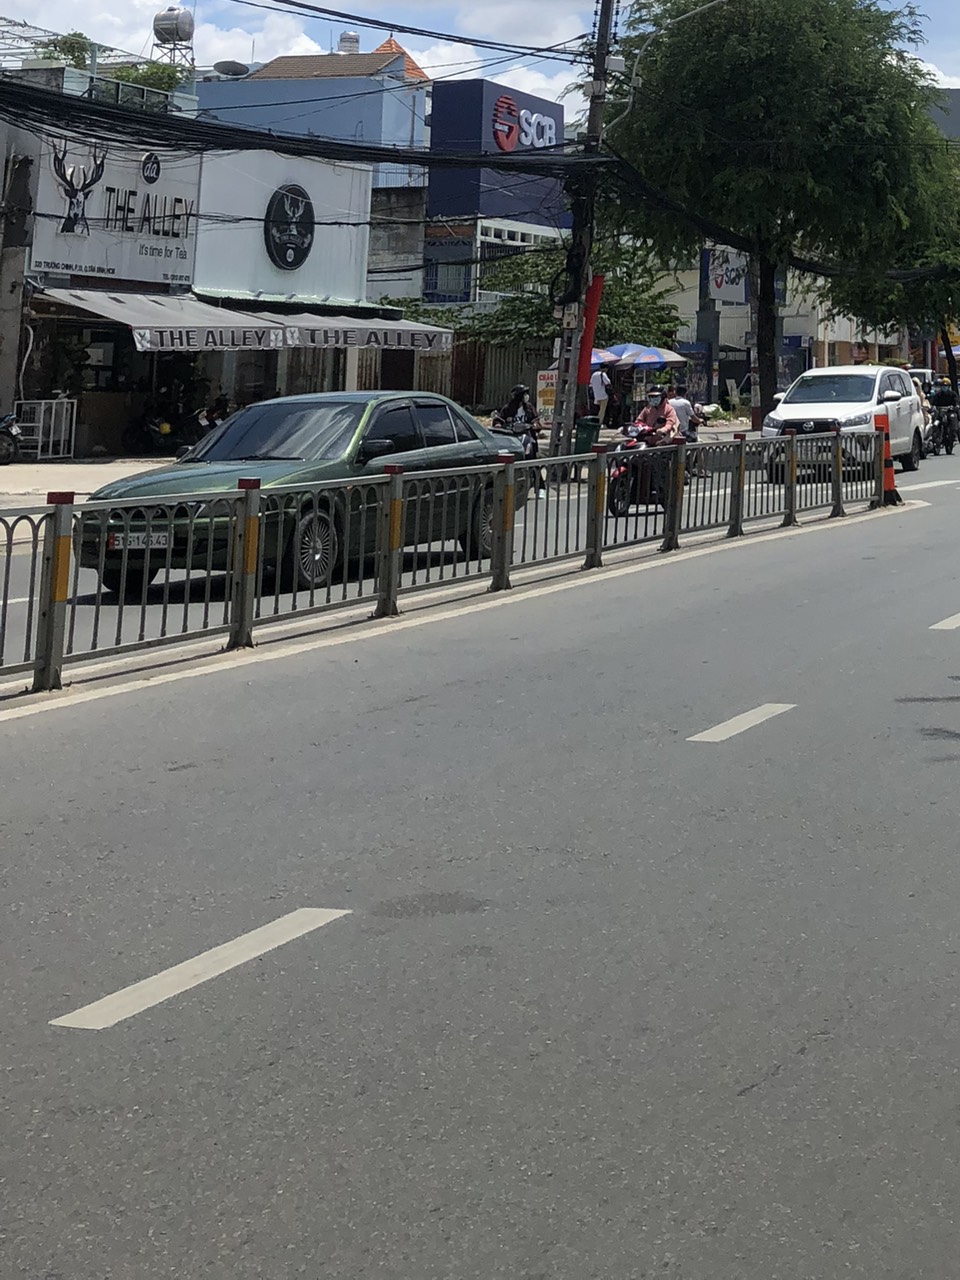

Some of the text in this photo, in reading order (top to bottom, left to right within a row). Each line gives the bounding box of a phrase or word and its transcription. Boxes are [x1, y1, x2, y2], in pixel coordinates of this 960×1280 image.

[520, 109, 556, 148] SCB
[106, 186, 195, 239] THE ALLEY
[138, 243, 188, 260] It's time for Tea
[154, 329, 266, 347] THE ALLEY
[304, 328, 438, 348] THE ALLEY
